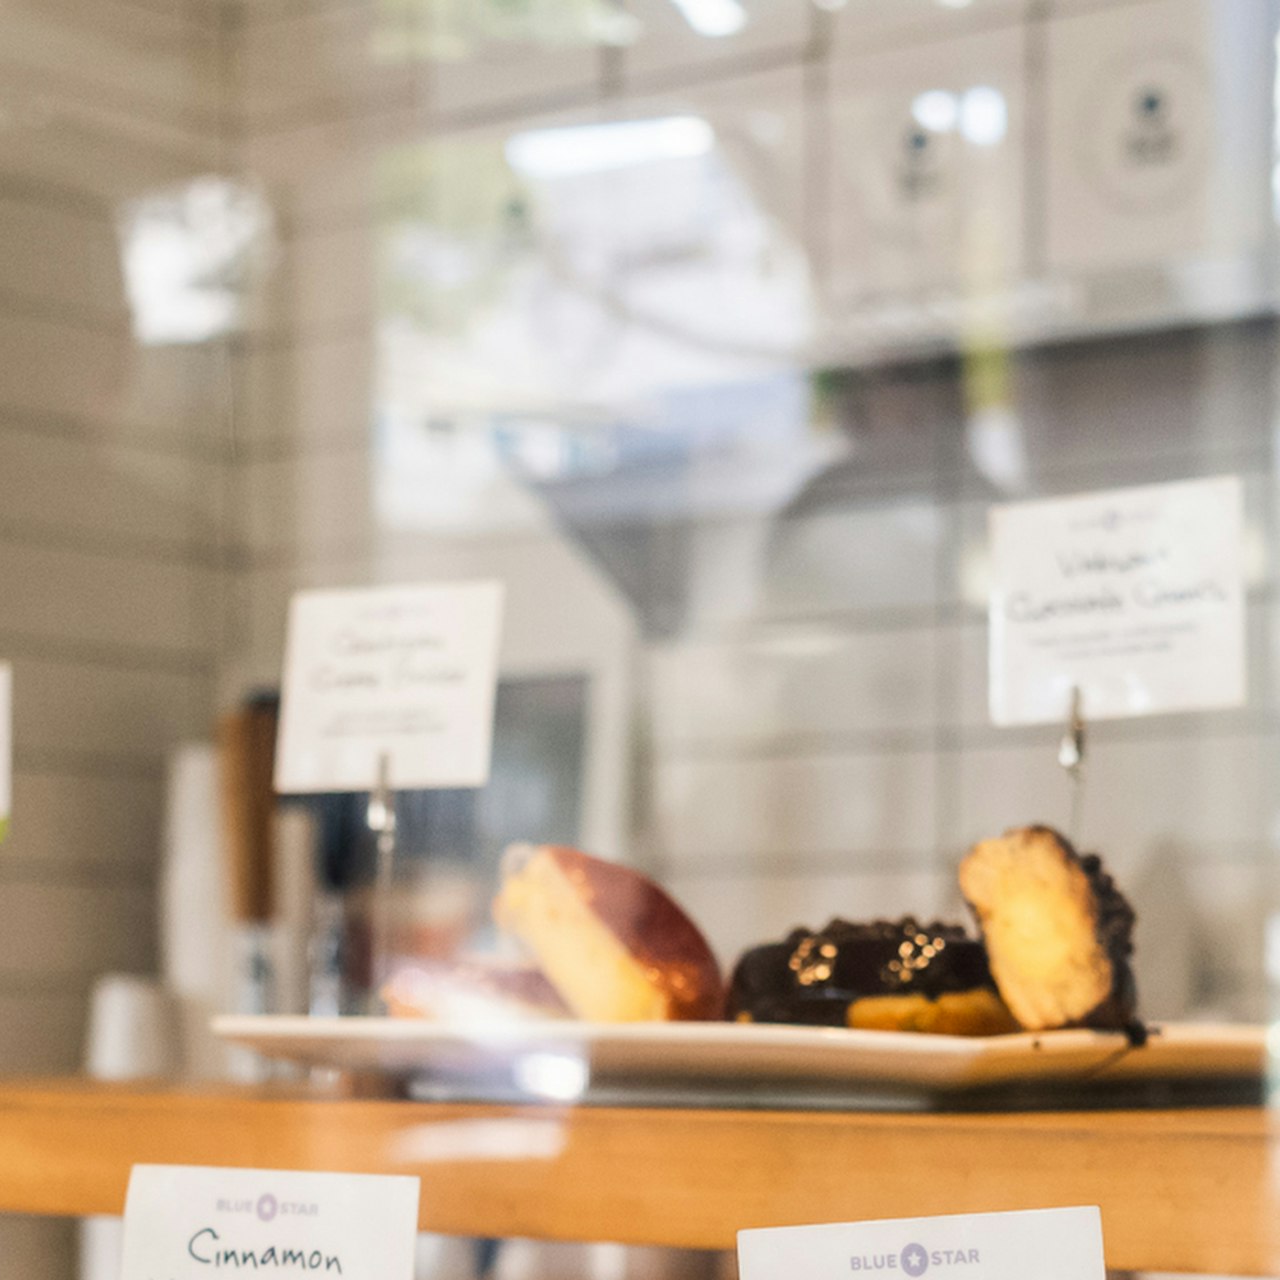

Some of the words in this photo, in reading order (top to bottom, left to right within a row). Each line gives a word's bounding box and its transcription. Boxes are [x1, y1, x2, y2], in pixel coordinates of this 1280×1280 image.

[216, 1199, 253, 1213] BLUE
[279, 1203, 318, 1216] STAR
[188, 1228, 343, 1275] Cinnamon
[850, 1253, 897, 1271] BLUE
[931, 1249, 980, 1265] STAR
